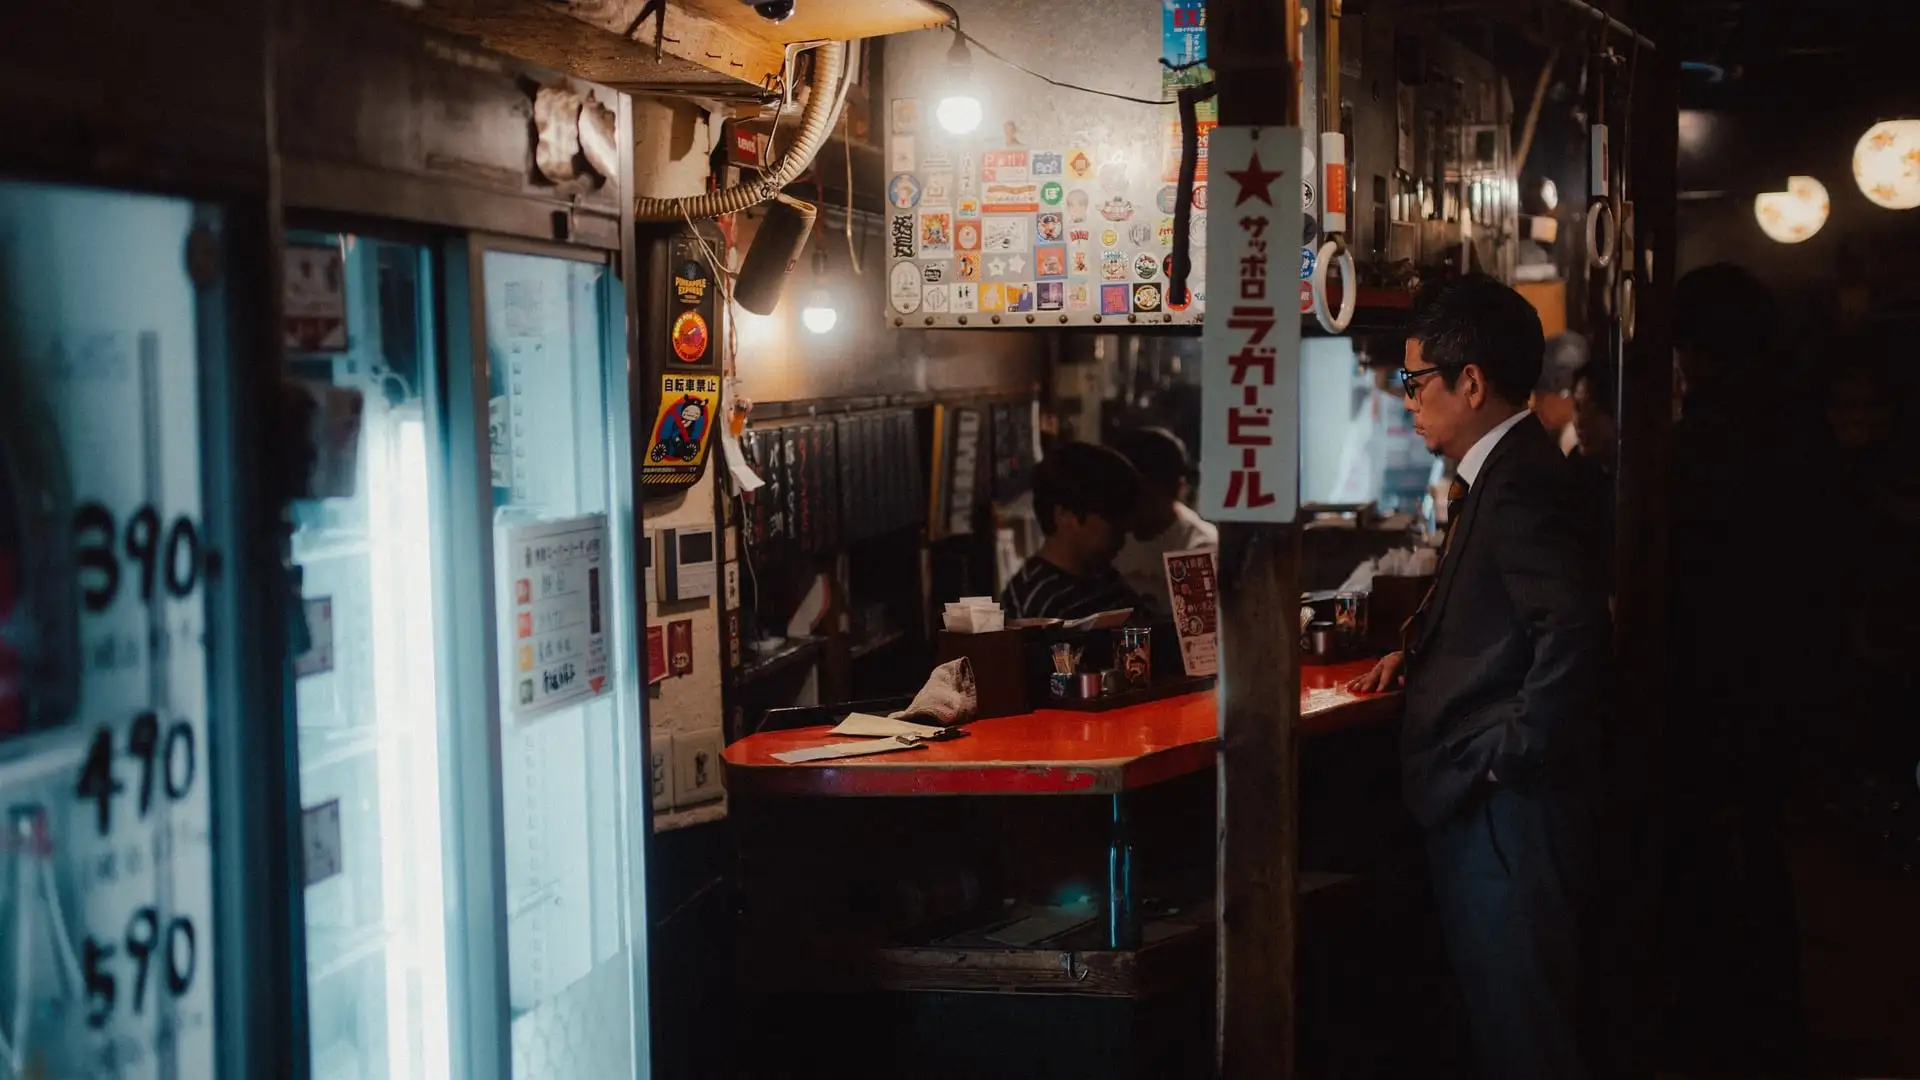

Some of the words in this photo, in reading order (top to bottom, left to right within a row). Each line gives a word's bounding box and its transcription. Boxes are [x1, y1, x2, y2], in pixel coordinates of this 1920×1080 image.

[664, 378, 716, 393] 自転車禁止
[72, 503, 199, 611] 390
[76, 712, 195, 835] 490
[82, 907, 195, 1030] 590
